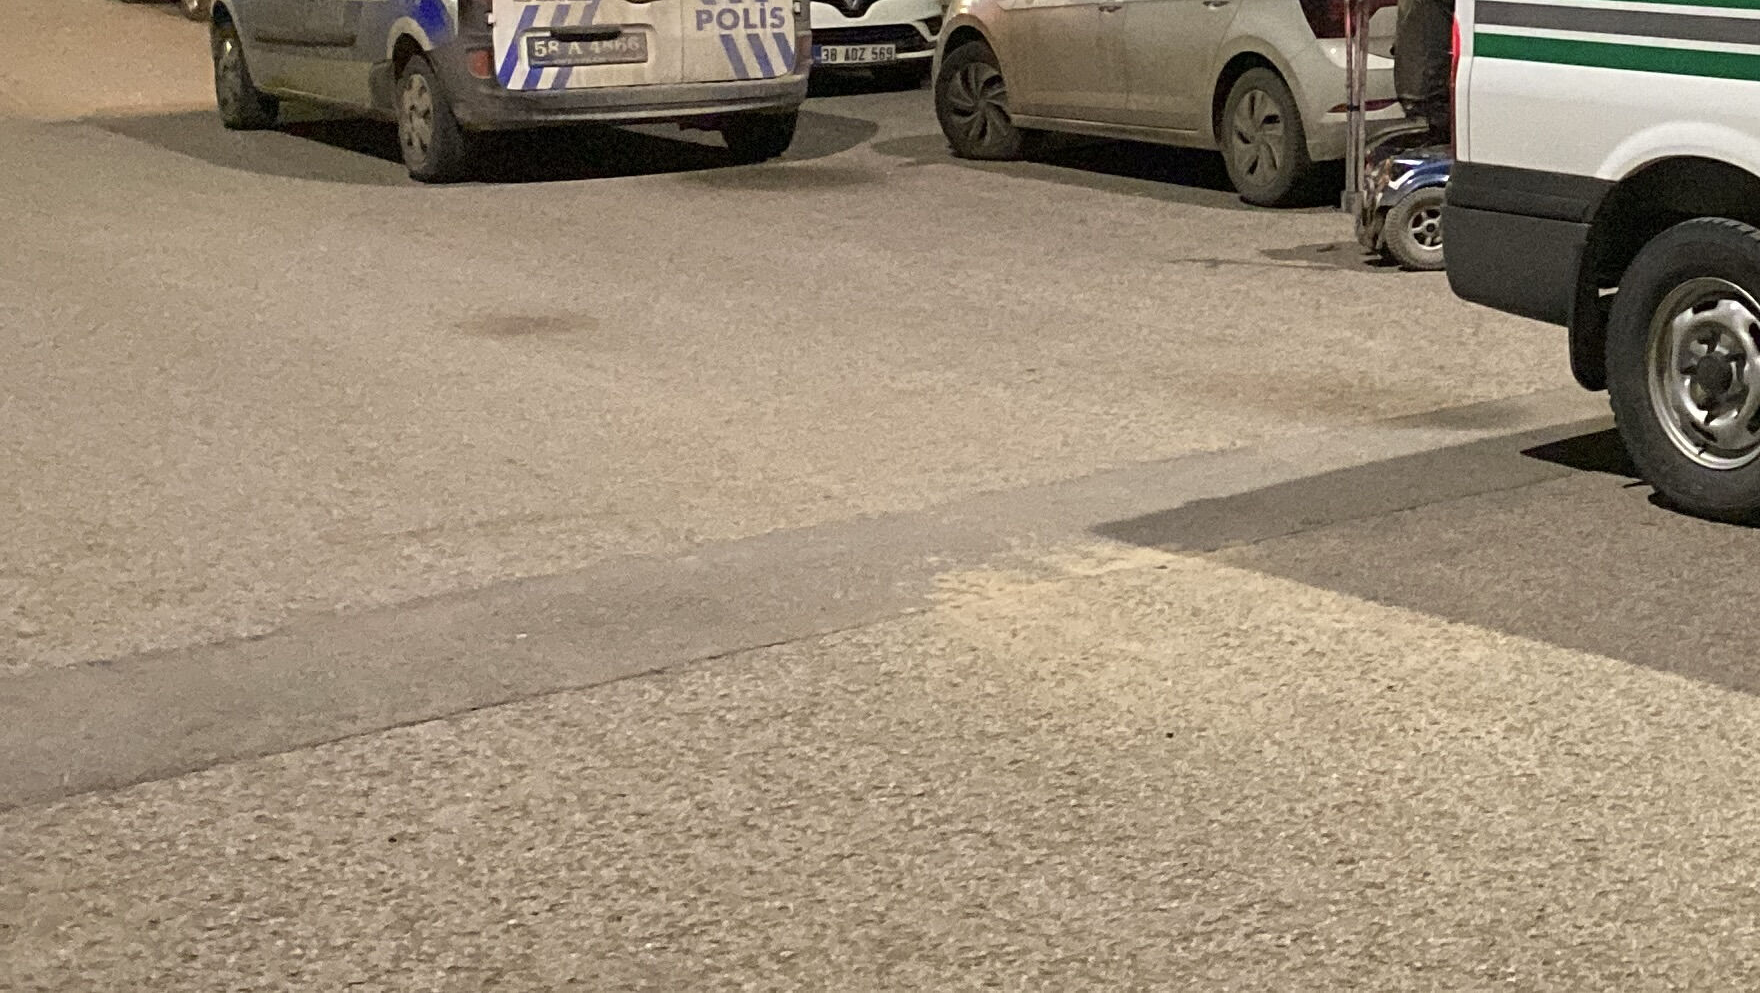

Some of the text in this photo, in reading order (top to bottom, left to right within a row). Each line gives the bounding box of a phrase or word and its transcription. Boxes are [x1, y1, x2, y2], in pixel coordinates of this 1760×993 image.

[695, 3, 786, 31] POLİS
[533, 40, 560, 58] 58
[567, 41, 583, 56] A
[822, 47, 838, 63] 38
[871, 46, 894, 62] 569
